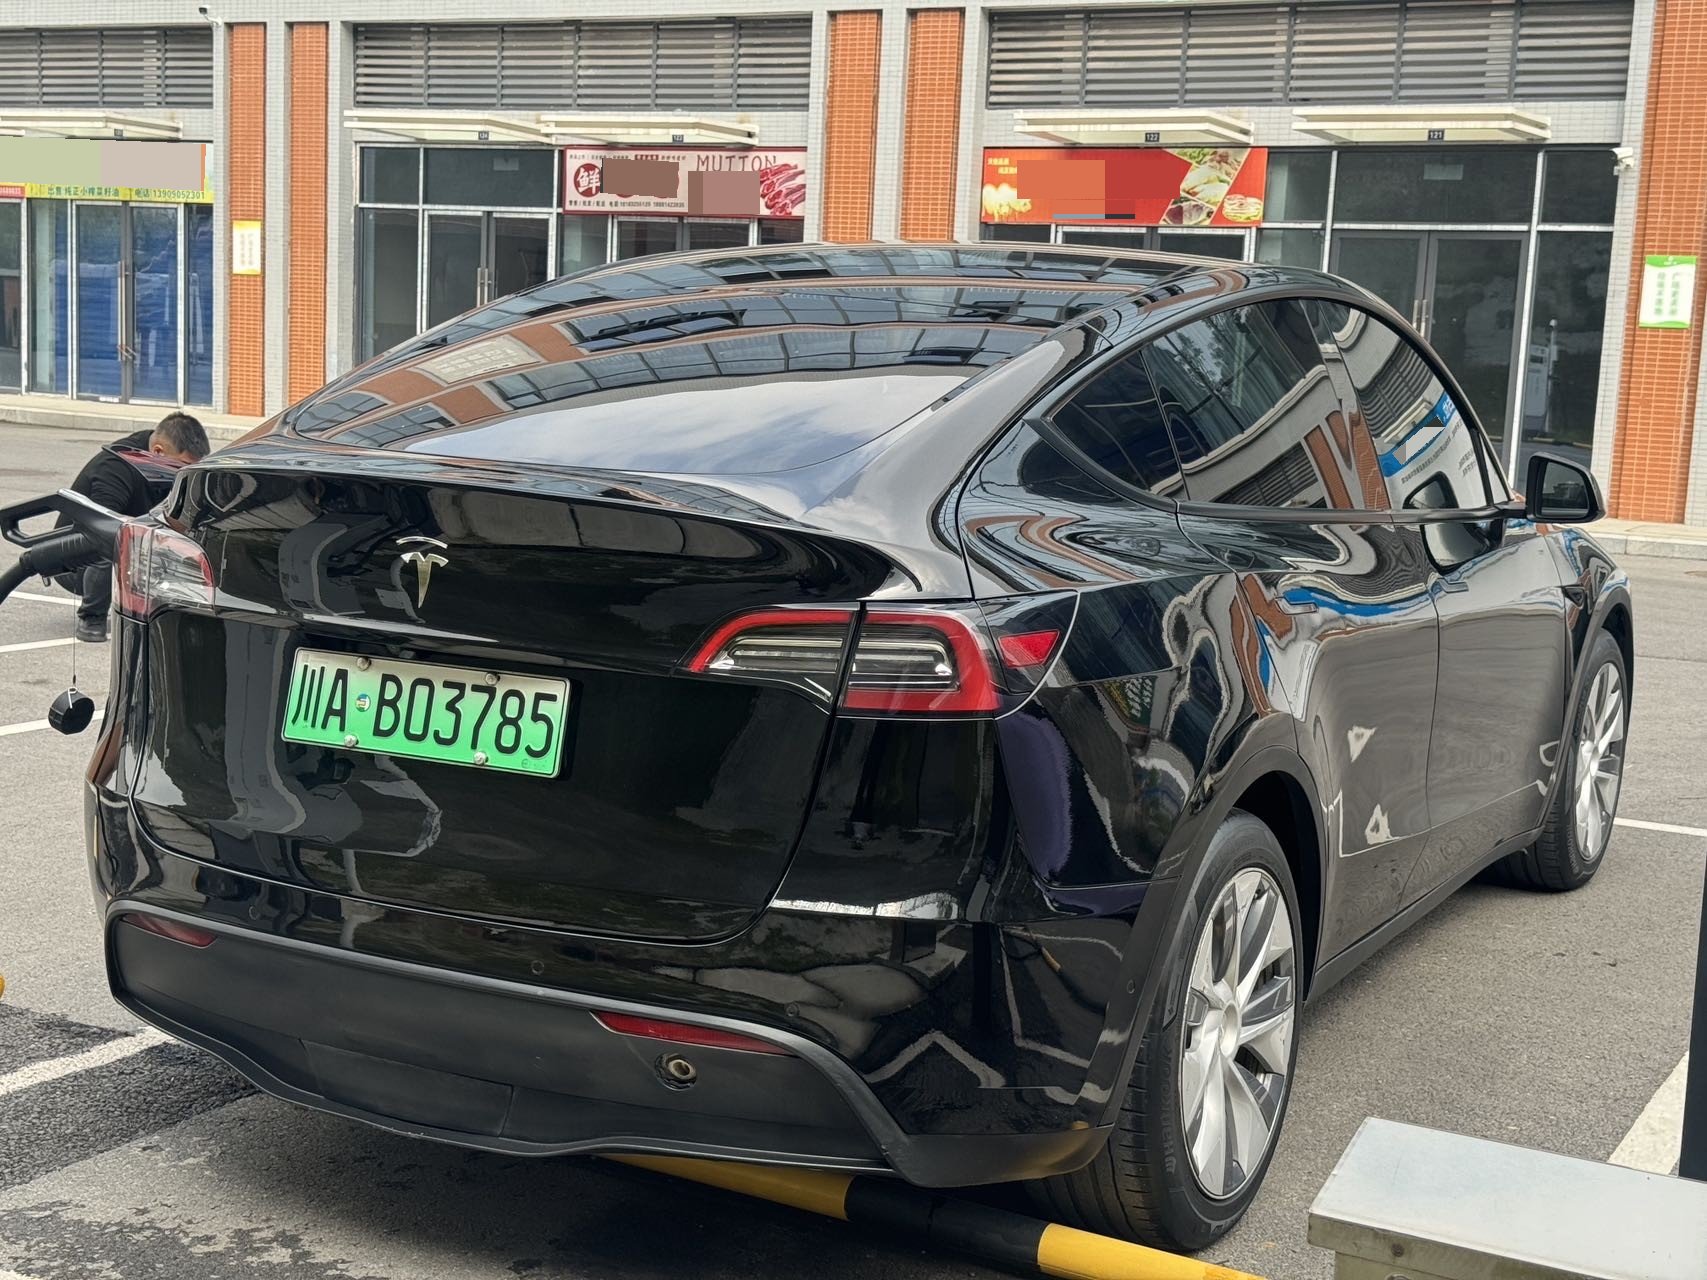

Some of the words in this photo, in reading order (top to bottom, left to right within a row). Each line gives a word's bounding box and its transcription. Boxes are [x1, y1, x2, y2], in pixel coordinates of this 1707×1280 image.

[1146, 133, 1158, 141] 122
[1430, 131, 1442, 139] 121
[696, 154, 777, 172] MUTTON
[577, 167, 601, 194] 鲜
